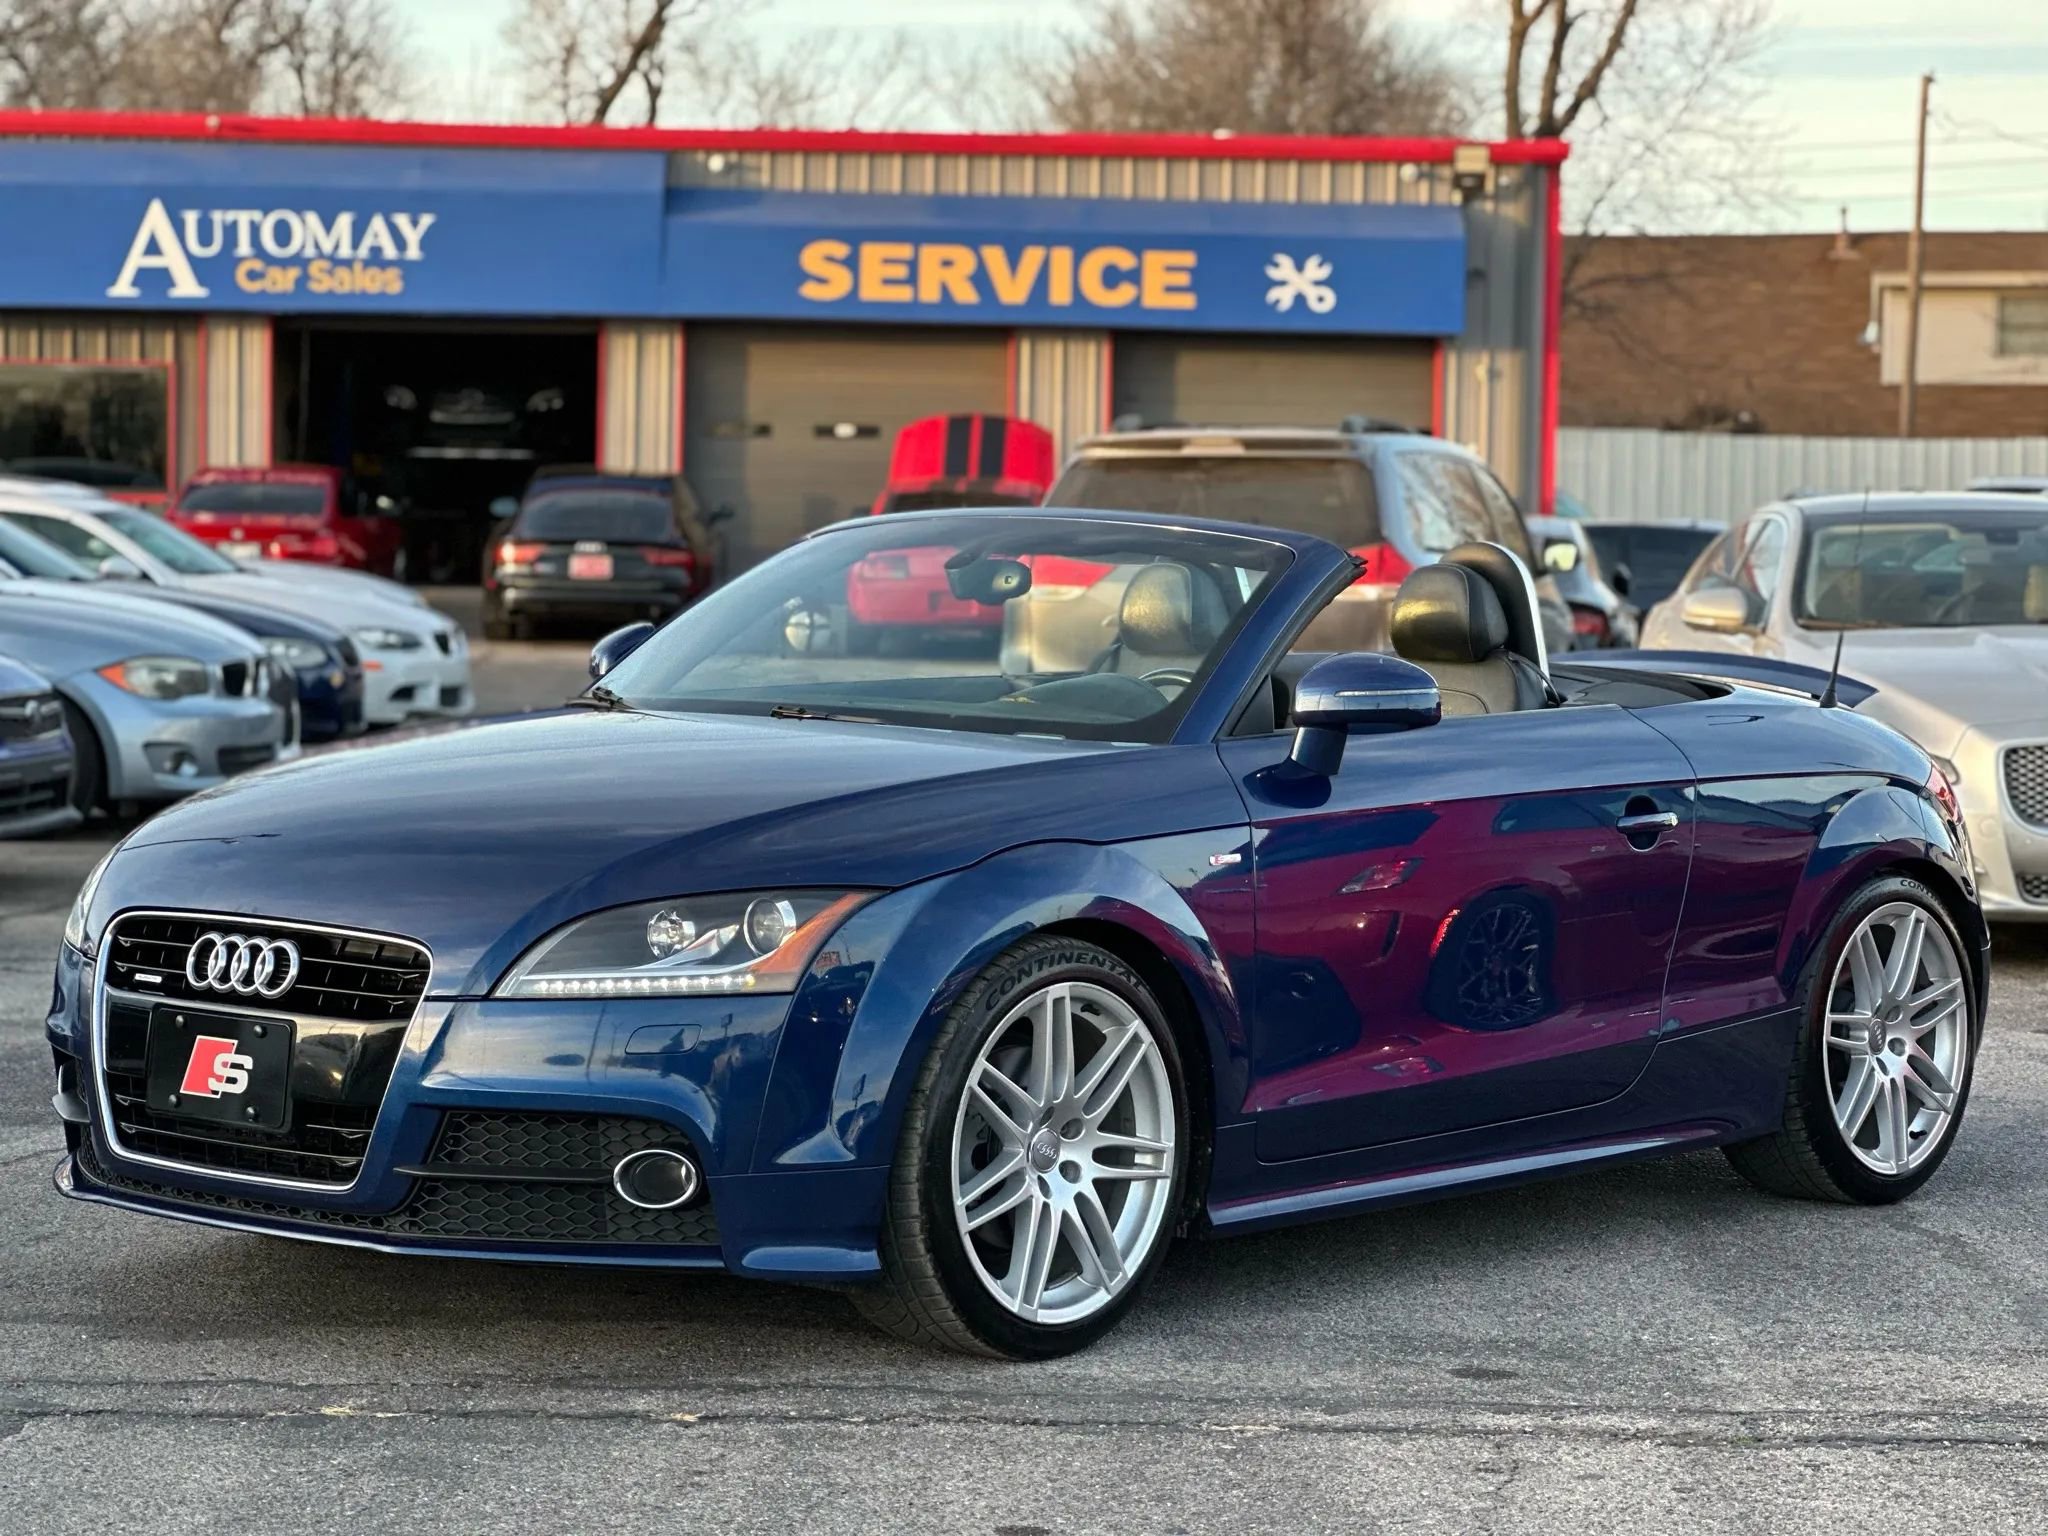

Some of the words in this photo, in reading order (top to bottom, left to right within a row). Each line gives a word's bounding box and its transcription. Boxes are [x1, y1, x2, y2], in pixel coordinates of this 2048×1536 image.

[105, 197, 436, 298] AUTOMAY
[234, 256, 301, 294] Car
[306, 257, 404, 296] Sales
[798, 239, 1198, 311] SERVICE
[985, 950, 1145, 1011] CONTINENTAL
[207, 1052, 254, 1095] S
